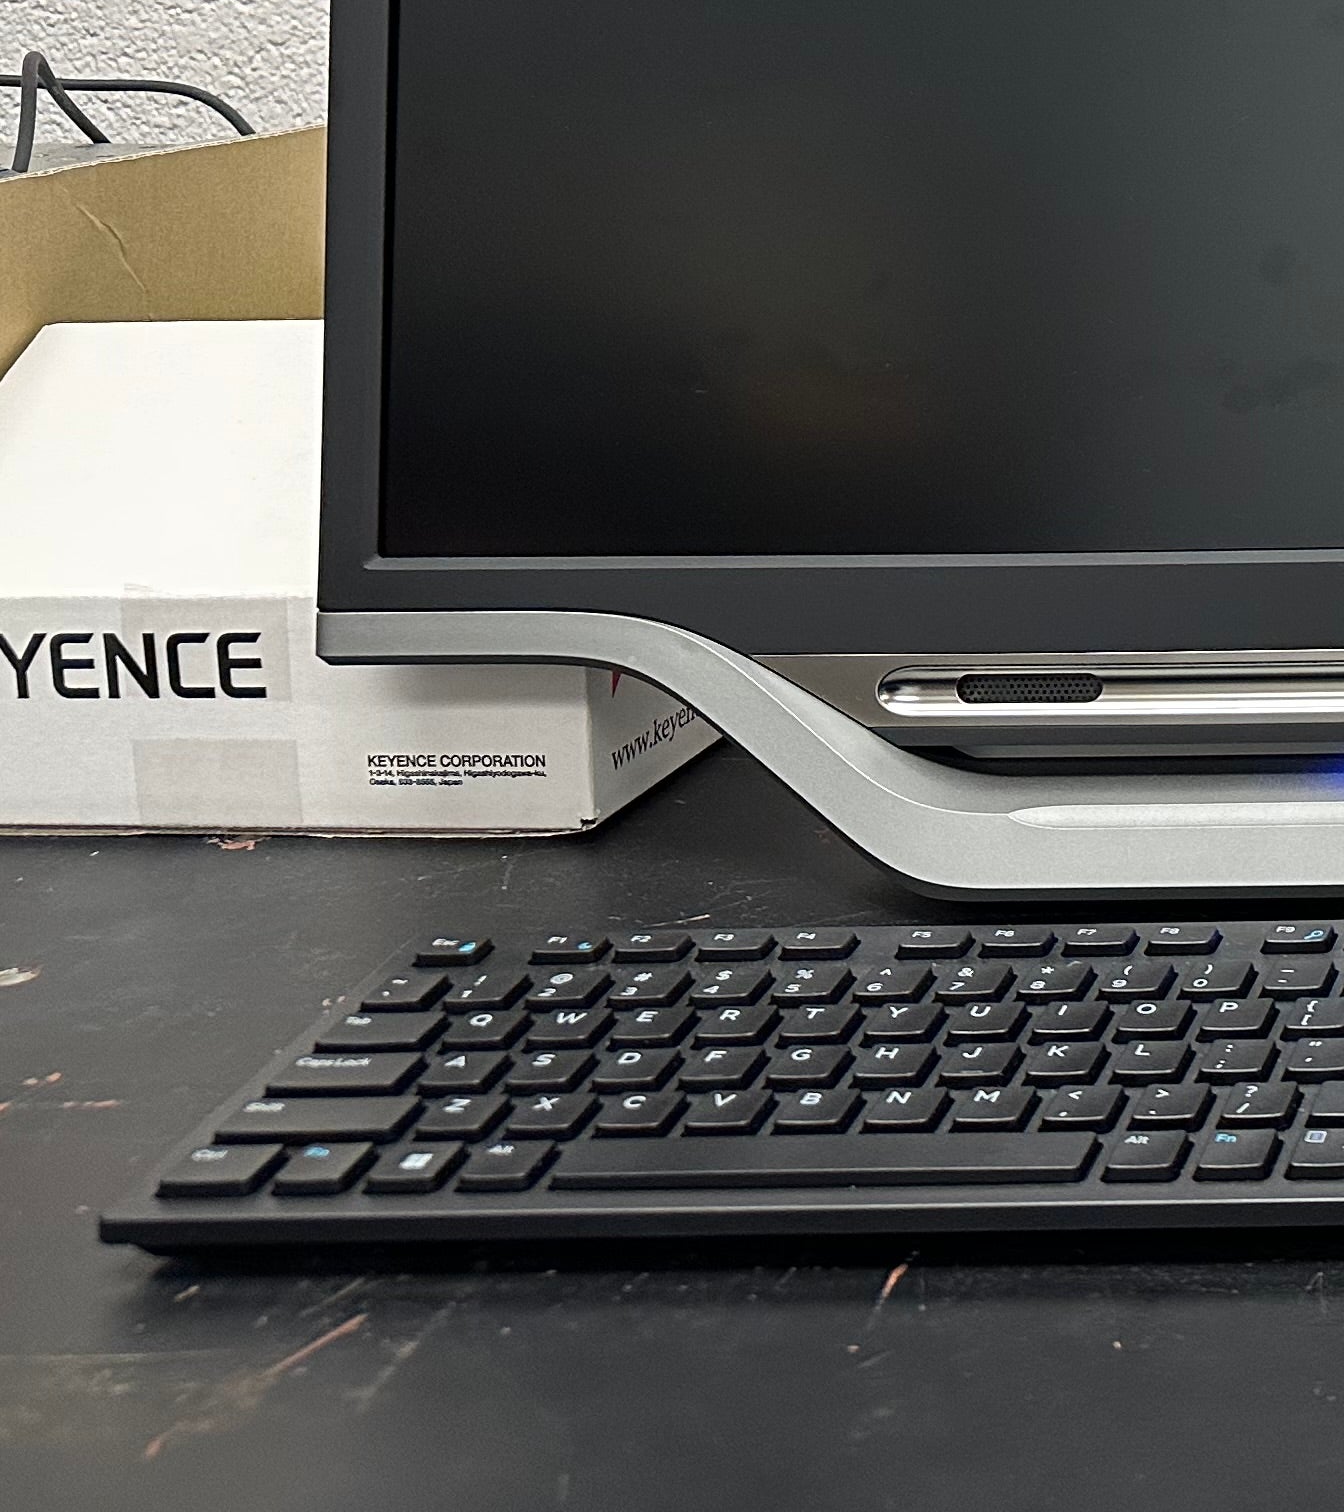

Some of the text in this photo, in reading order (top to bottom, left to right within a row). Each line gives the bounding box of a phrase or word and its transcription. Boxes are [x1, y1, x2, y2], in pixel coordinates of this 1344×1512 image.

[0, 631, 268, 699] YENCE
[367, 754, 547, 767] KEYENCE CORPORATION
[796, 932, 816, 940] F4
[911, 930, 932, 938] F5
[994, 929, 1015, 937] F6
[1076, 928, 1097, 936] F7
[547, 936, 568, 944] F1
[630, 935, 652, 943] F2
[806, 1007, 826, 1020] T
[889, 1006, 909, 1019] Y
[970, 1005, 992, 1018] U
[1057, 1004, 1068, 1016] I
[1136, 1003, 1157, 1015] O
[1219, 1001, 1239, 1013] P
[469, 1013, 493, 1027] Q
[556, 1012, 588, 1024] W
[635, 1010, 659, 1023] E
[719, 1009, 741, 1021] R
[704, 1050, 727, 1063] F
[790, 1048, 813, 1061] G
[874, 1046, 900, 1060] H
[962, 1046, 983, 1059] J
[1047, 1045, 1070, 1057] K
[1134, 1044, 1151, 1056] L
[444, 1055, 466, 1068] A
[532, 1053, 556, 1067] S
[617, 1052, 642, 1065] D
[623, 1095, 647, 1109] C
[714, 1093, 737, 1107] V
[799, 1092, 823, 1105] B
[885, 1090, 912, 1105] N
[973, 1089, 1001, 1103] M
[444, 1098, 472, 1113] Z
[532, 1096, 560, 1111] X
[1124, 1135, 1150, 1145] Alt
[1214, 1133, 1237, 1143] Fn
